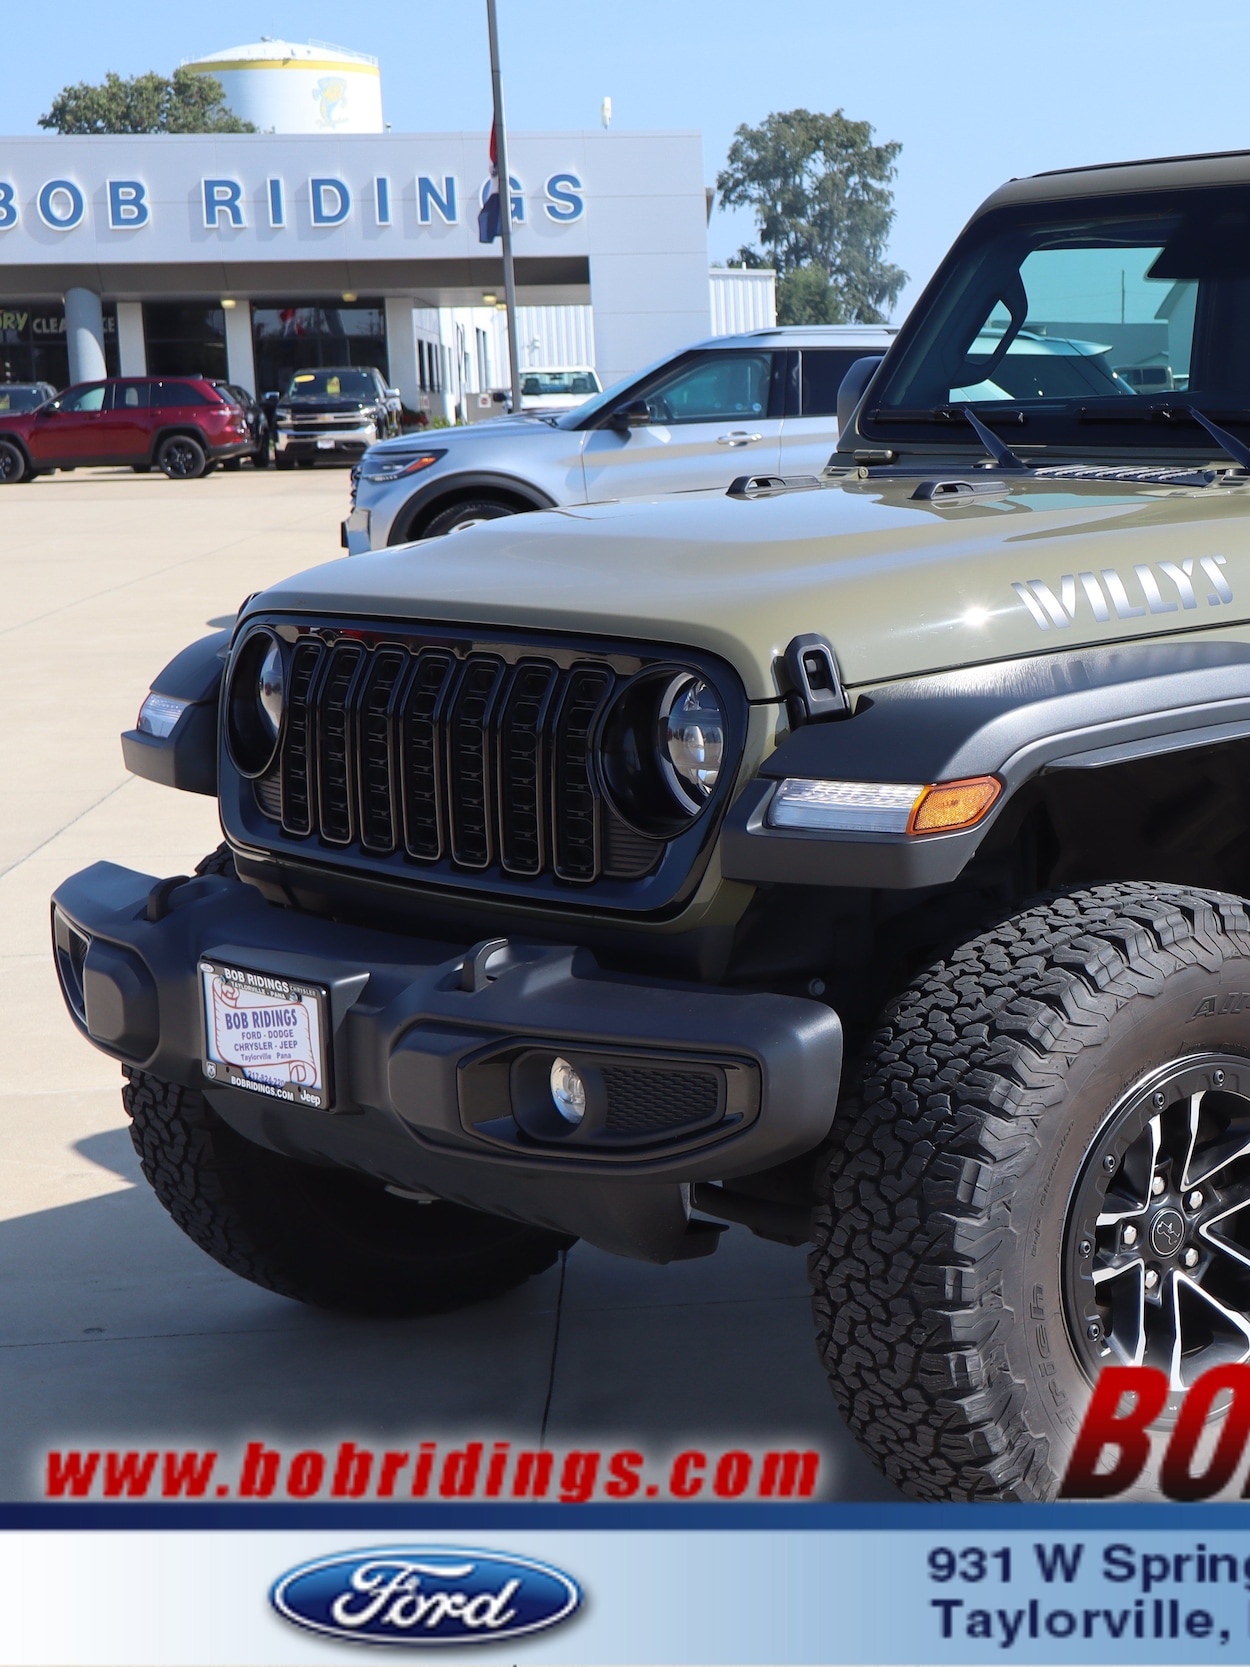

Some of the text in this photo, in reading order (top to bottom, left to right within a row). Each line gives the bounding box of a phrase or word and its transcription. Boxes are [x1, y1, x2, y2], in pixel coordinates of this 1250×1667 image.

[202, 173, 585, 228] RIDINGS
[0, 312, 115, 333] RY CLEACE
[1010, 554, 1233, 631] WILLYS
[224, 968, 245, 983] BOB
[246, 973, 290, 994] RIDINGS
[290, 985, 316, 996] CHRYSLER
[231, 981, 266, 995] TAYLORVILLE
[270, 991, 287, 1000] PANA
[225, 1008, 297, 1030] BOB RIDINGS
[241, 1031, 262, 1040] FORD
[268, 1029, 294, 1039] DODGE
[234, 1042, 273, 1052] CHRYSLER
[280, 1040, 298, 1049] JEEP
[241, 1053, 272, 1062] Taylorville
[248, 1070, 286, 1087] 217-824-220
[231, 1076, 321, 1107] BOBRIDINGS.COM Jeep
